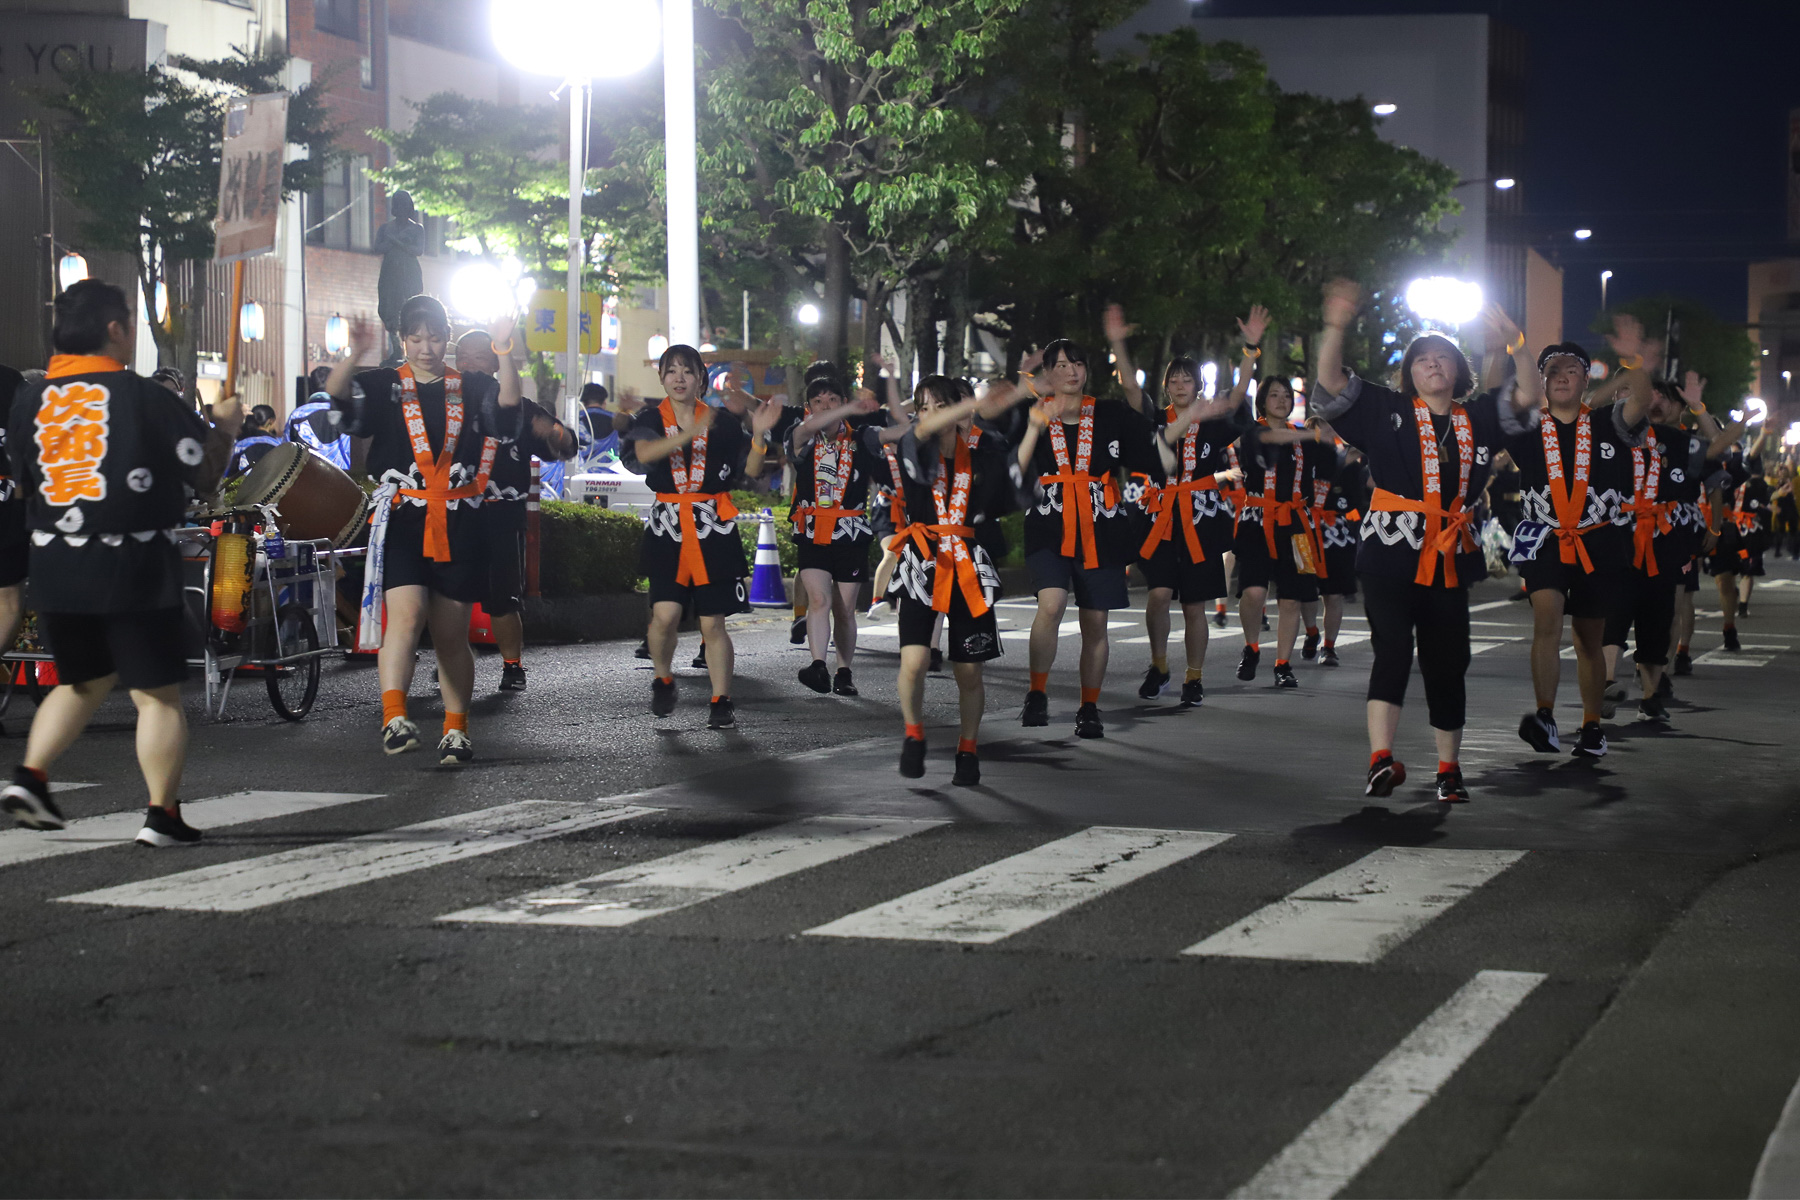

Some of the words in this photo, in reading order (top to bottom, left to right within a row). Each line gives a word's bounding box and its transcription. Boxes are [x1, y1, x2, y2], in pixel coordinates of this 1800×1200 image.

[25, 42, 113, 74] YOU
[34, 381, 110, 506] 次郎長
[445, 377, 464, 454] 清次郎長
[1076, 404, 1095, 472] 清水次郎長
[1414, 406, 1441, 494] 清水次郎長
[1451, 414, 1473, 497] 清水次郎長
[1632, 446, 1645, 491] 次郎長
